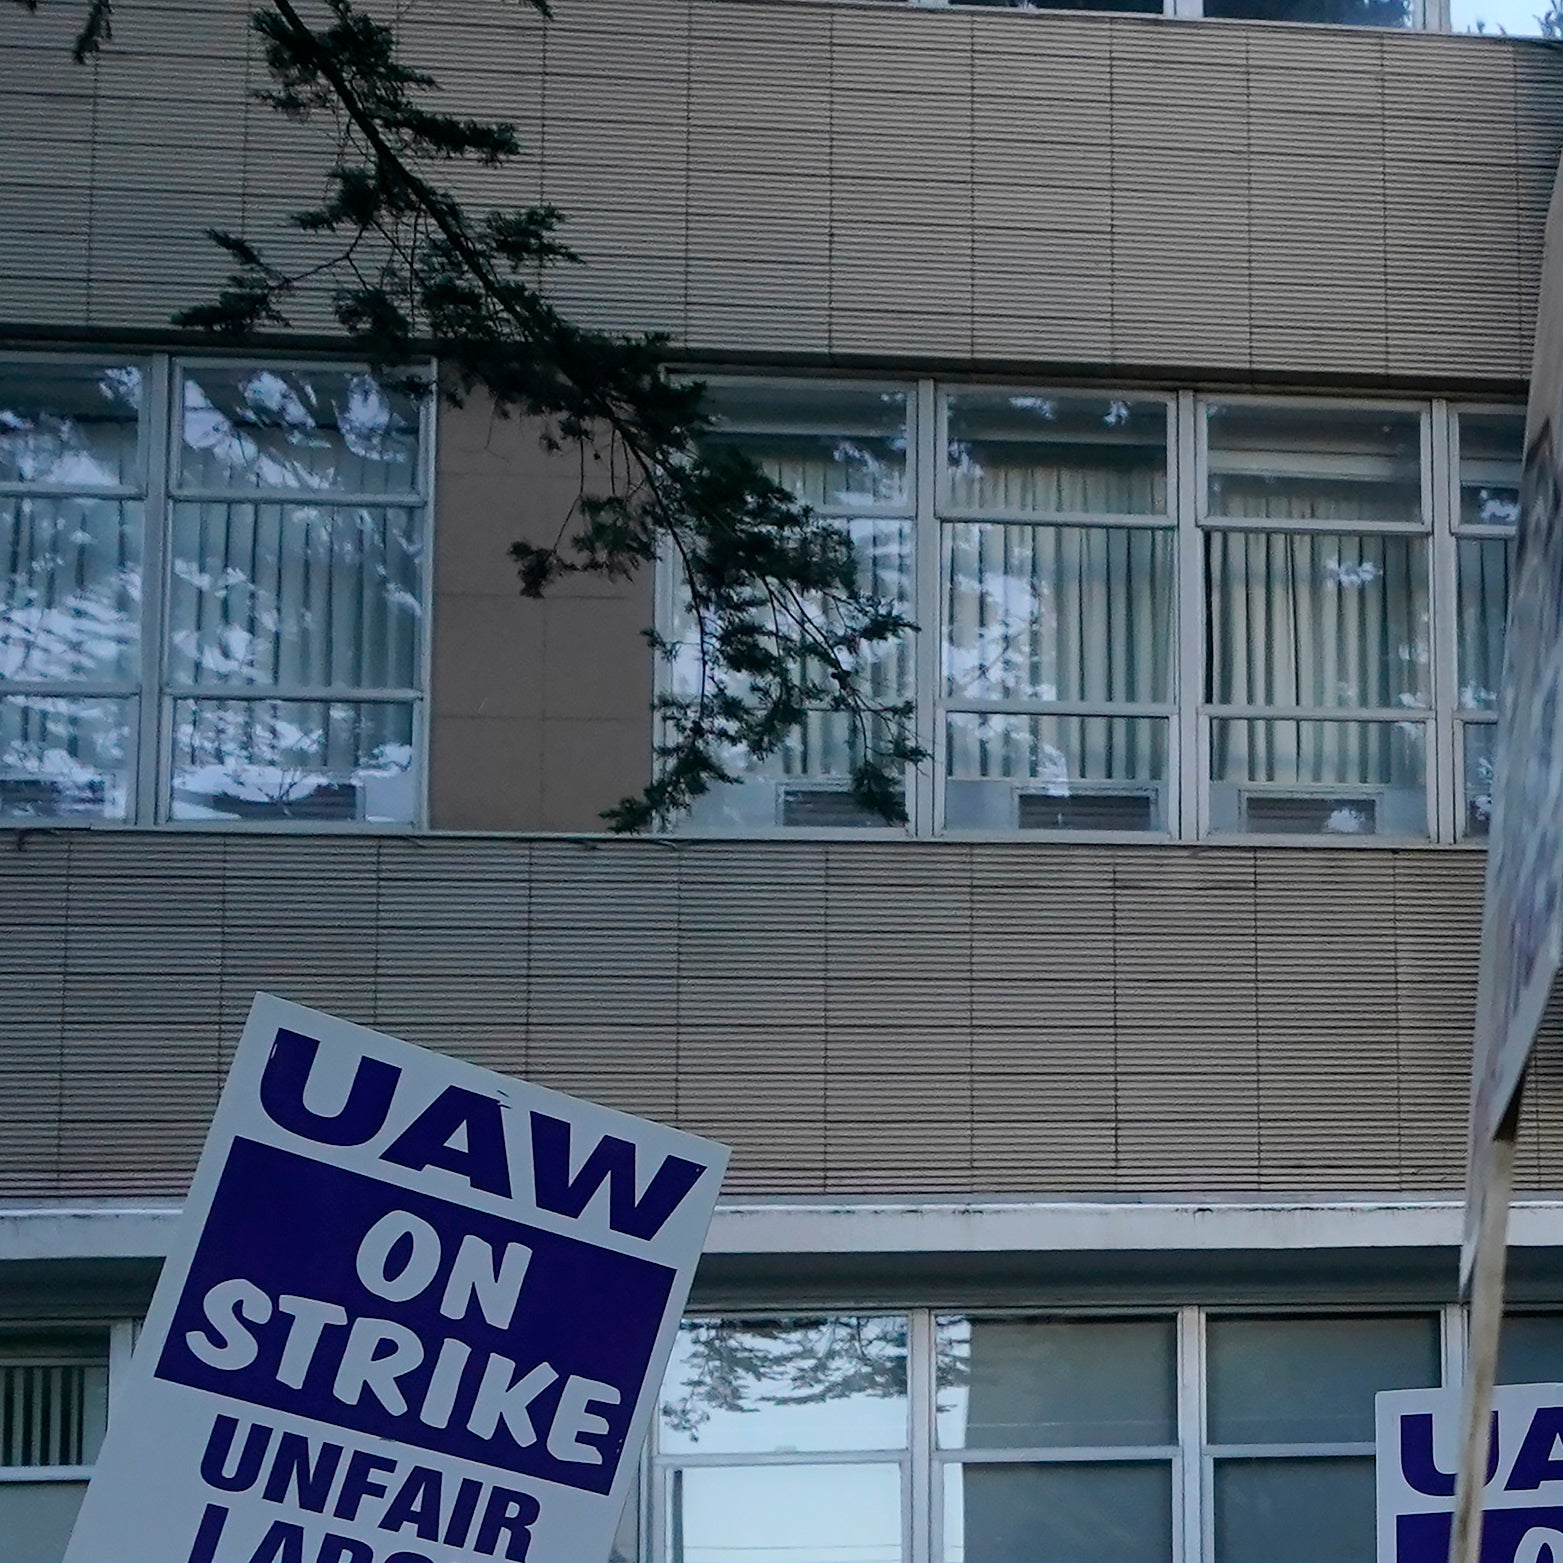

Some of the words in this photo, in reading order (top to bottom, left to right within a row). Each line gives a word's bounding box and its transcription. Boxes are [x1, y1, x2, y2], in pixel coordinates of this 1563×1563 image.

[260, 1027, 707, 1242] UAW
[356, 1209, 534, 1330] ON
[185, 1278, 623, 1467] STRIKE
[200, 1414, 541, 1563] UNFAIR
